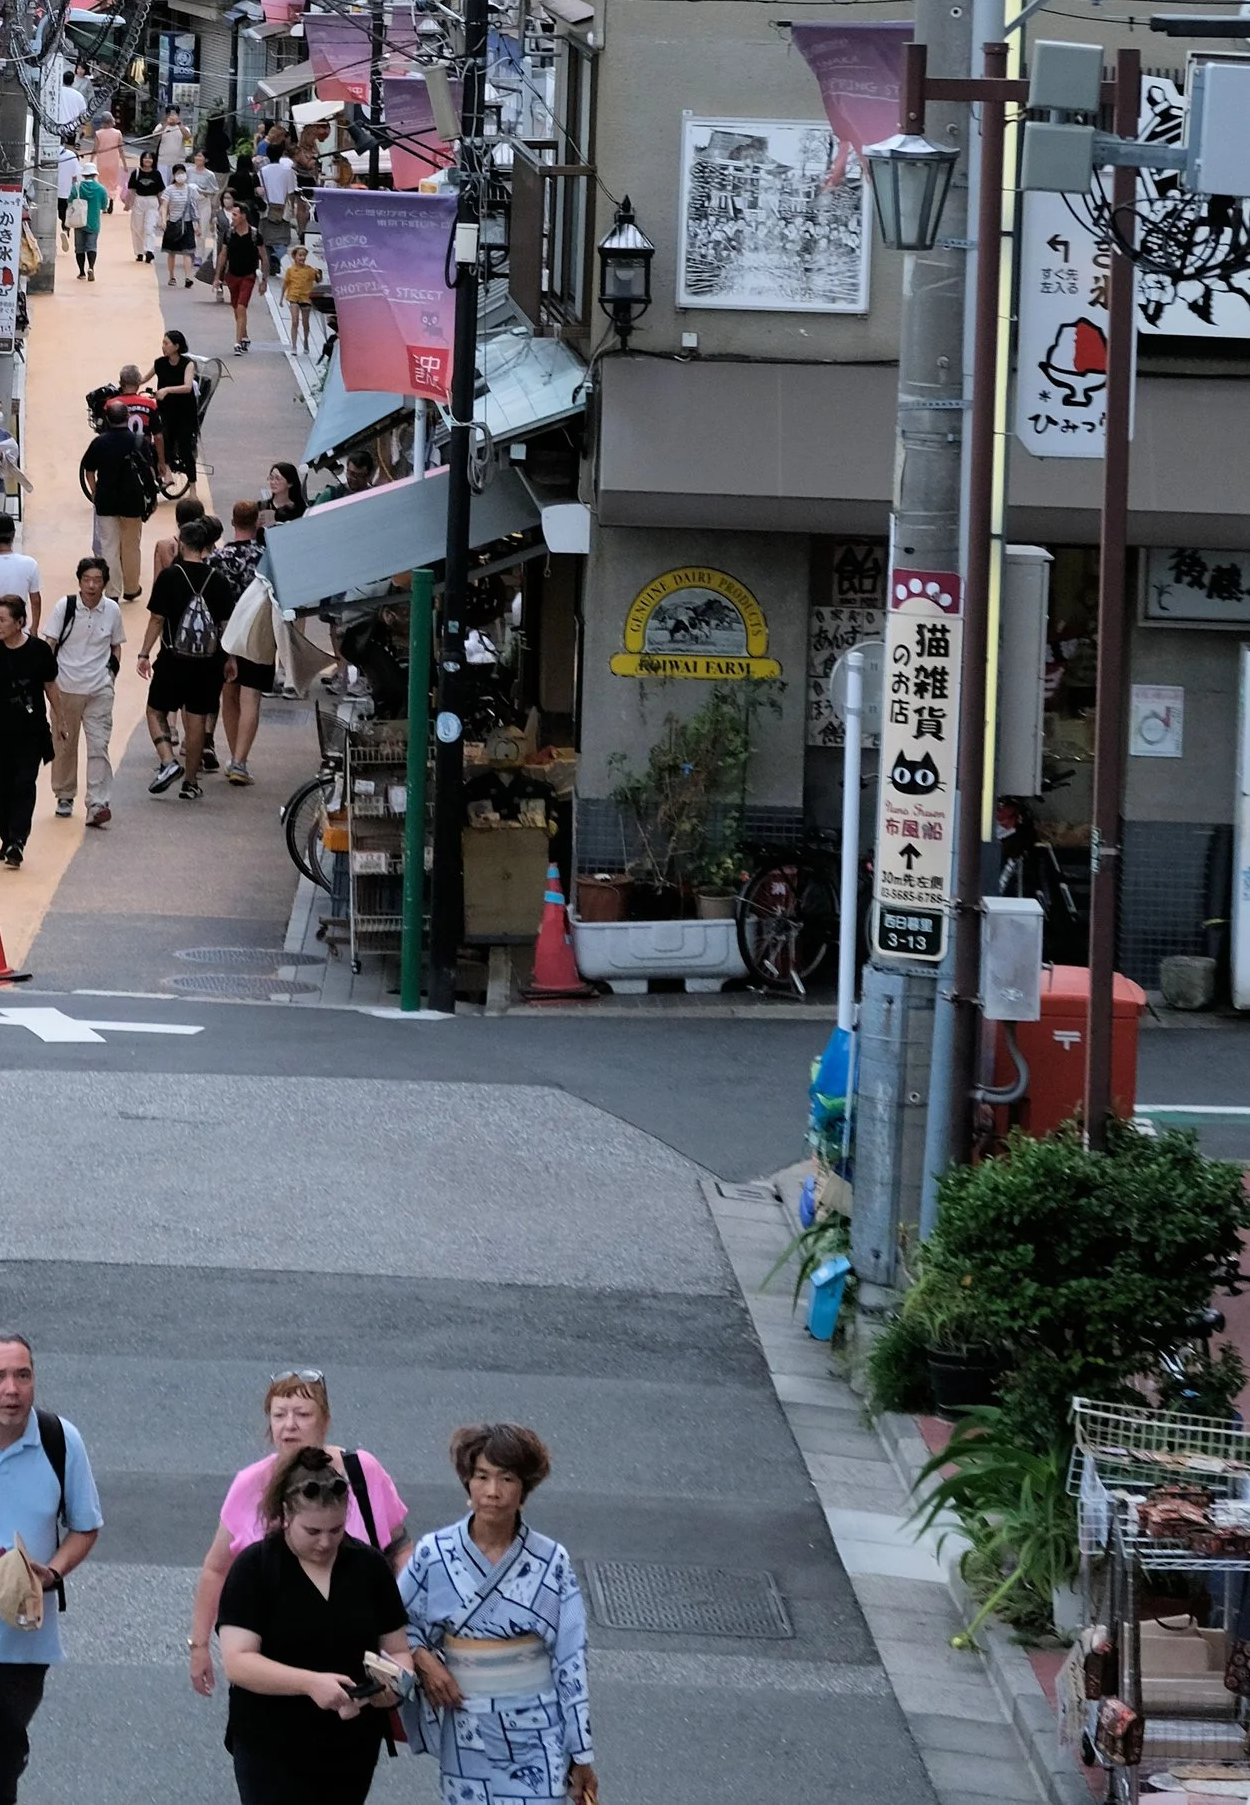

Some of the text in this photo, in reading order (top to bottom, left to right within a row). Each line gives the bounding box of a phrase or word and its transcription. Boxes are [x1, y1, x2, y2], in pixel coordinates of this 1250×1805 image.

[327, 234, 368, 248] TOKYO
[331, 256, 378, 272] YANAKA
[395, 286, 444, 301] STREET
[1027, 412, 1107, 436] ひみつ
[672, 570, 713, 586] DAIRY
[718, 577, 764, 638] PRODUCTS
[705, 659, 751, 676] FARM
[889, 643, 912, 725] のお店
[912, 623, 951, 742] 猫雑貨
[885, 817, 944, 841] 布風船
[881, 870, 944, 891] 30m先左側
[884, 913, 934, 933] 西日暮里
[886, 932, 928, 951] 3-13
